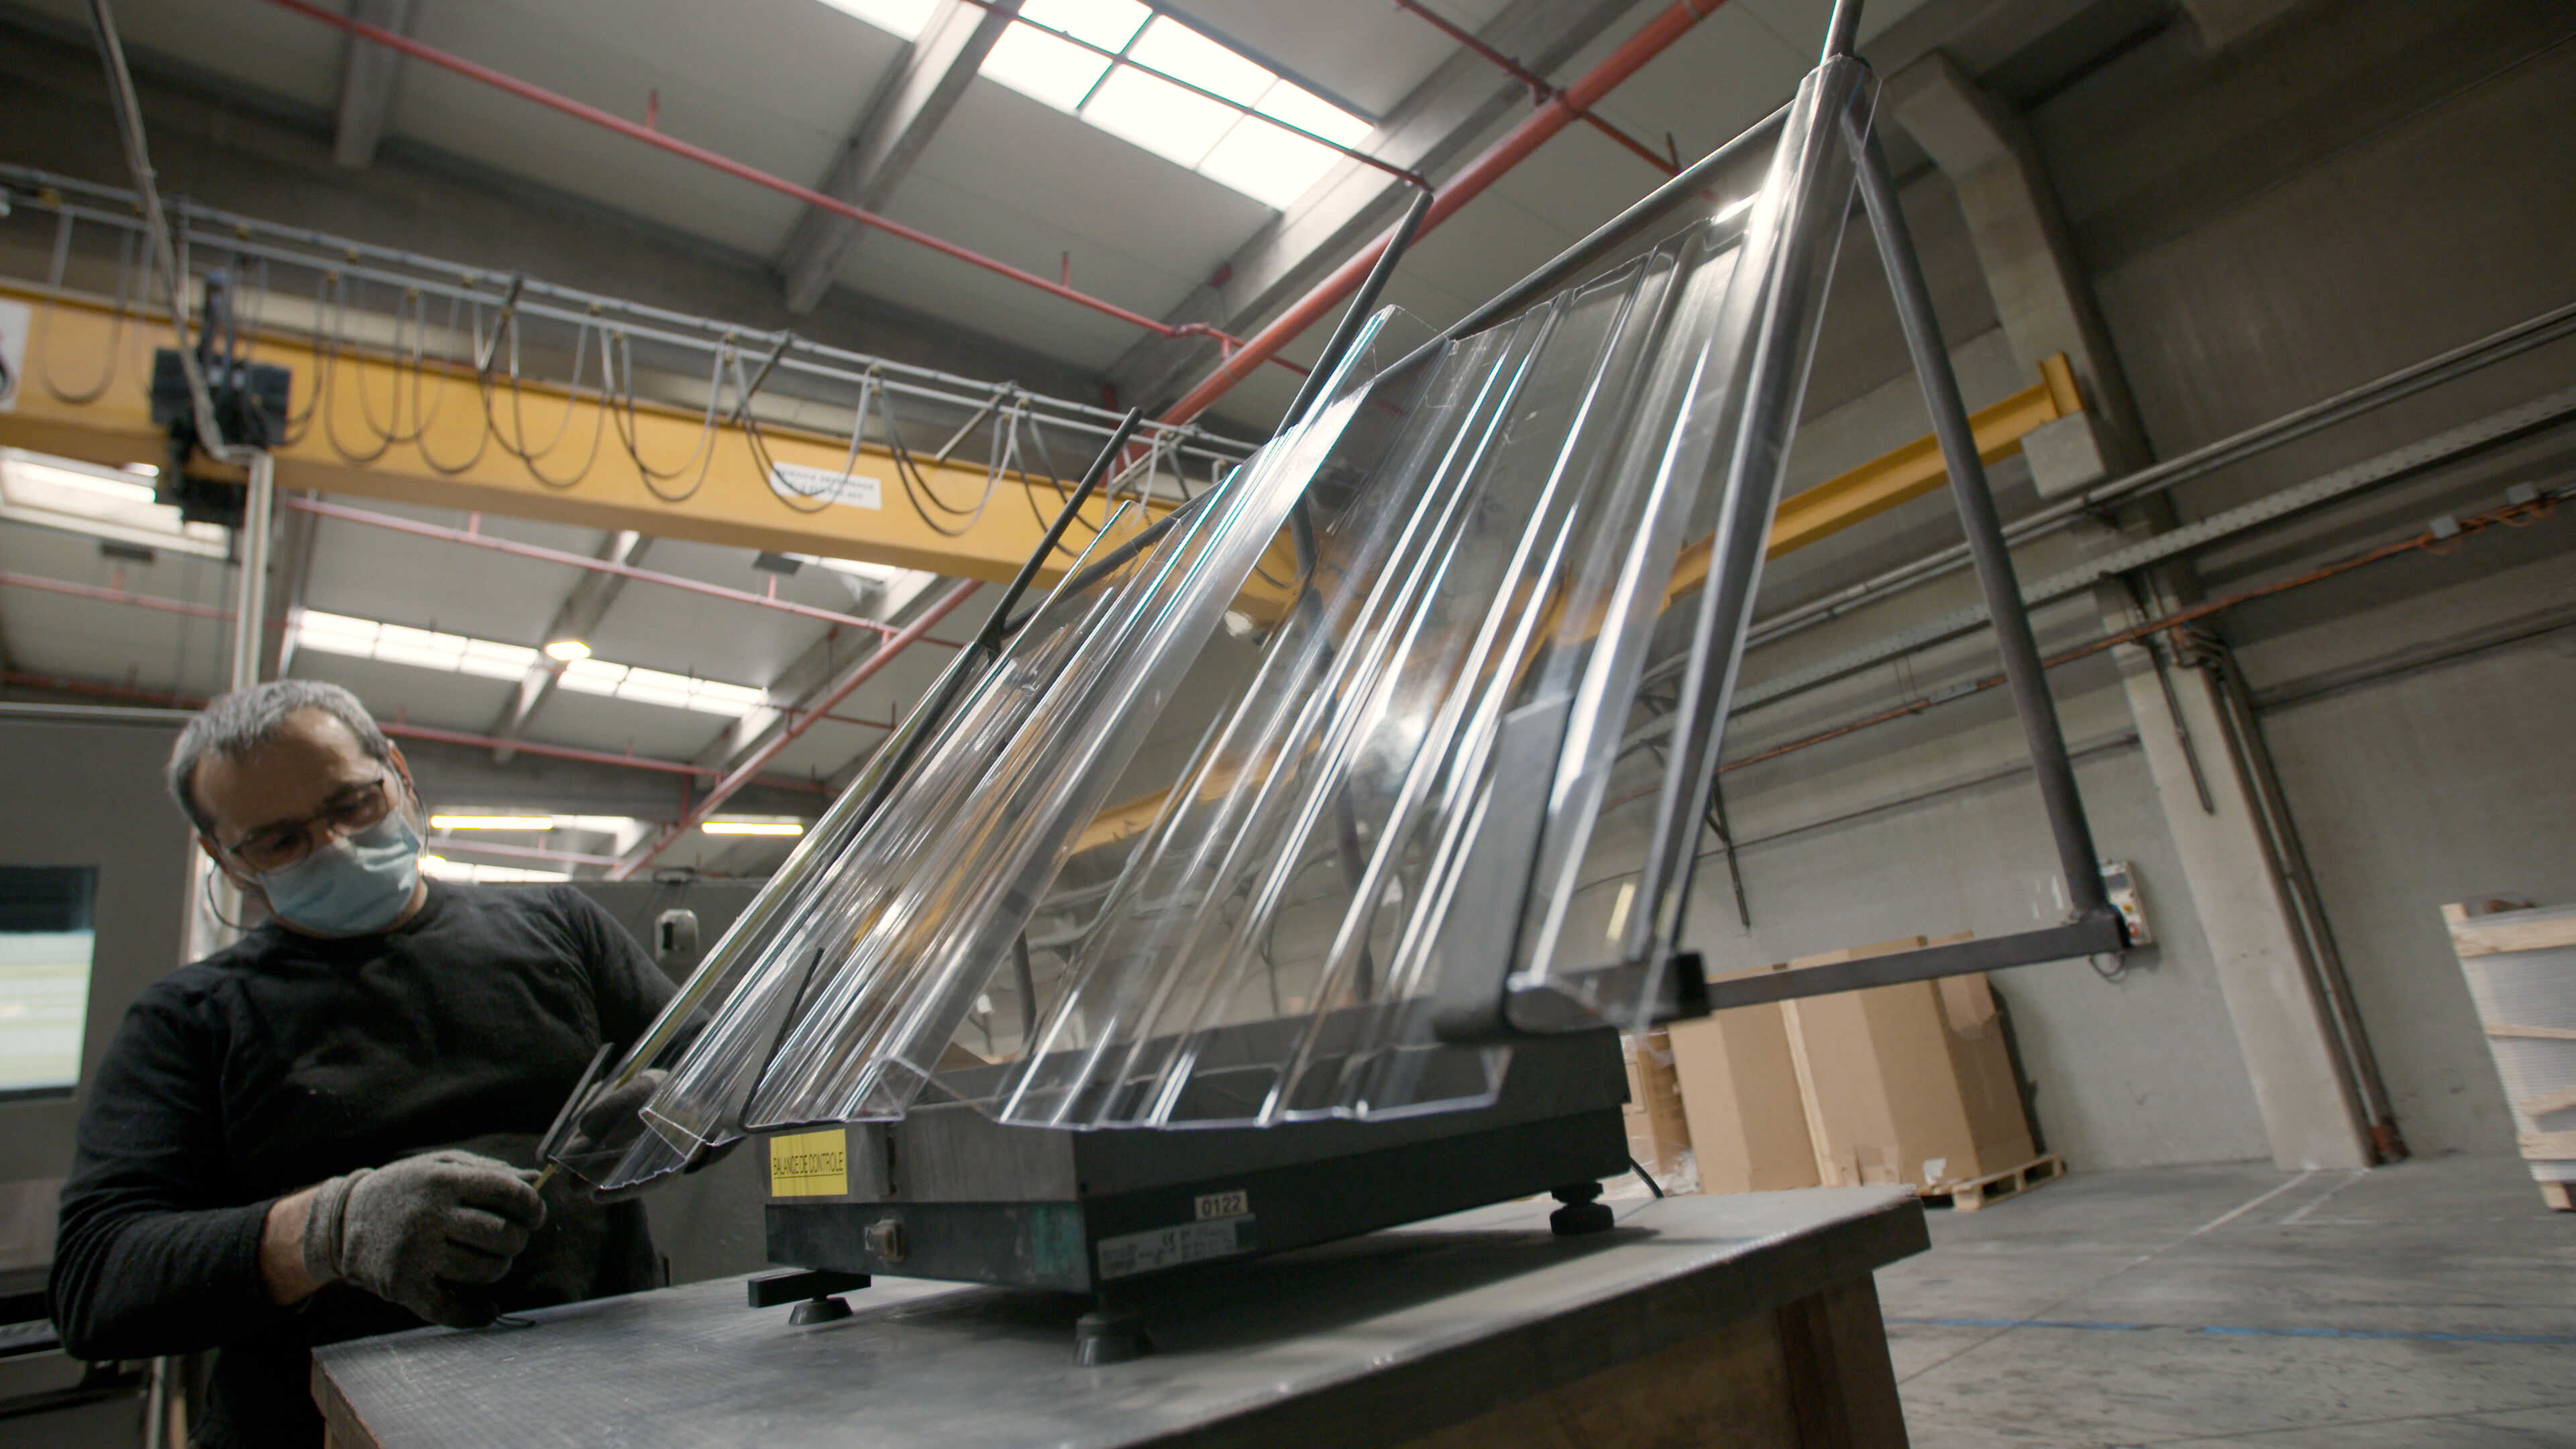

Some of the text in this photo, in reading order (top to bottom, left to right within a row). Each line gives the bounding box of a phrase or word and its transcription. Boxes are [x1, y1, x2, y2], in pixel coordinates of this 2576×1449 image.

[773, 1151, 843, 1176] BALANCE DE CONTROLE
[1201, 1195, 1240, 1216] 0122
